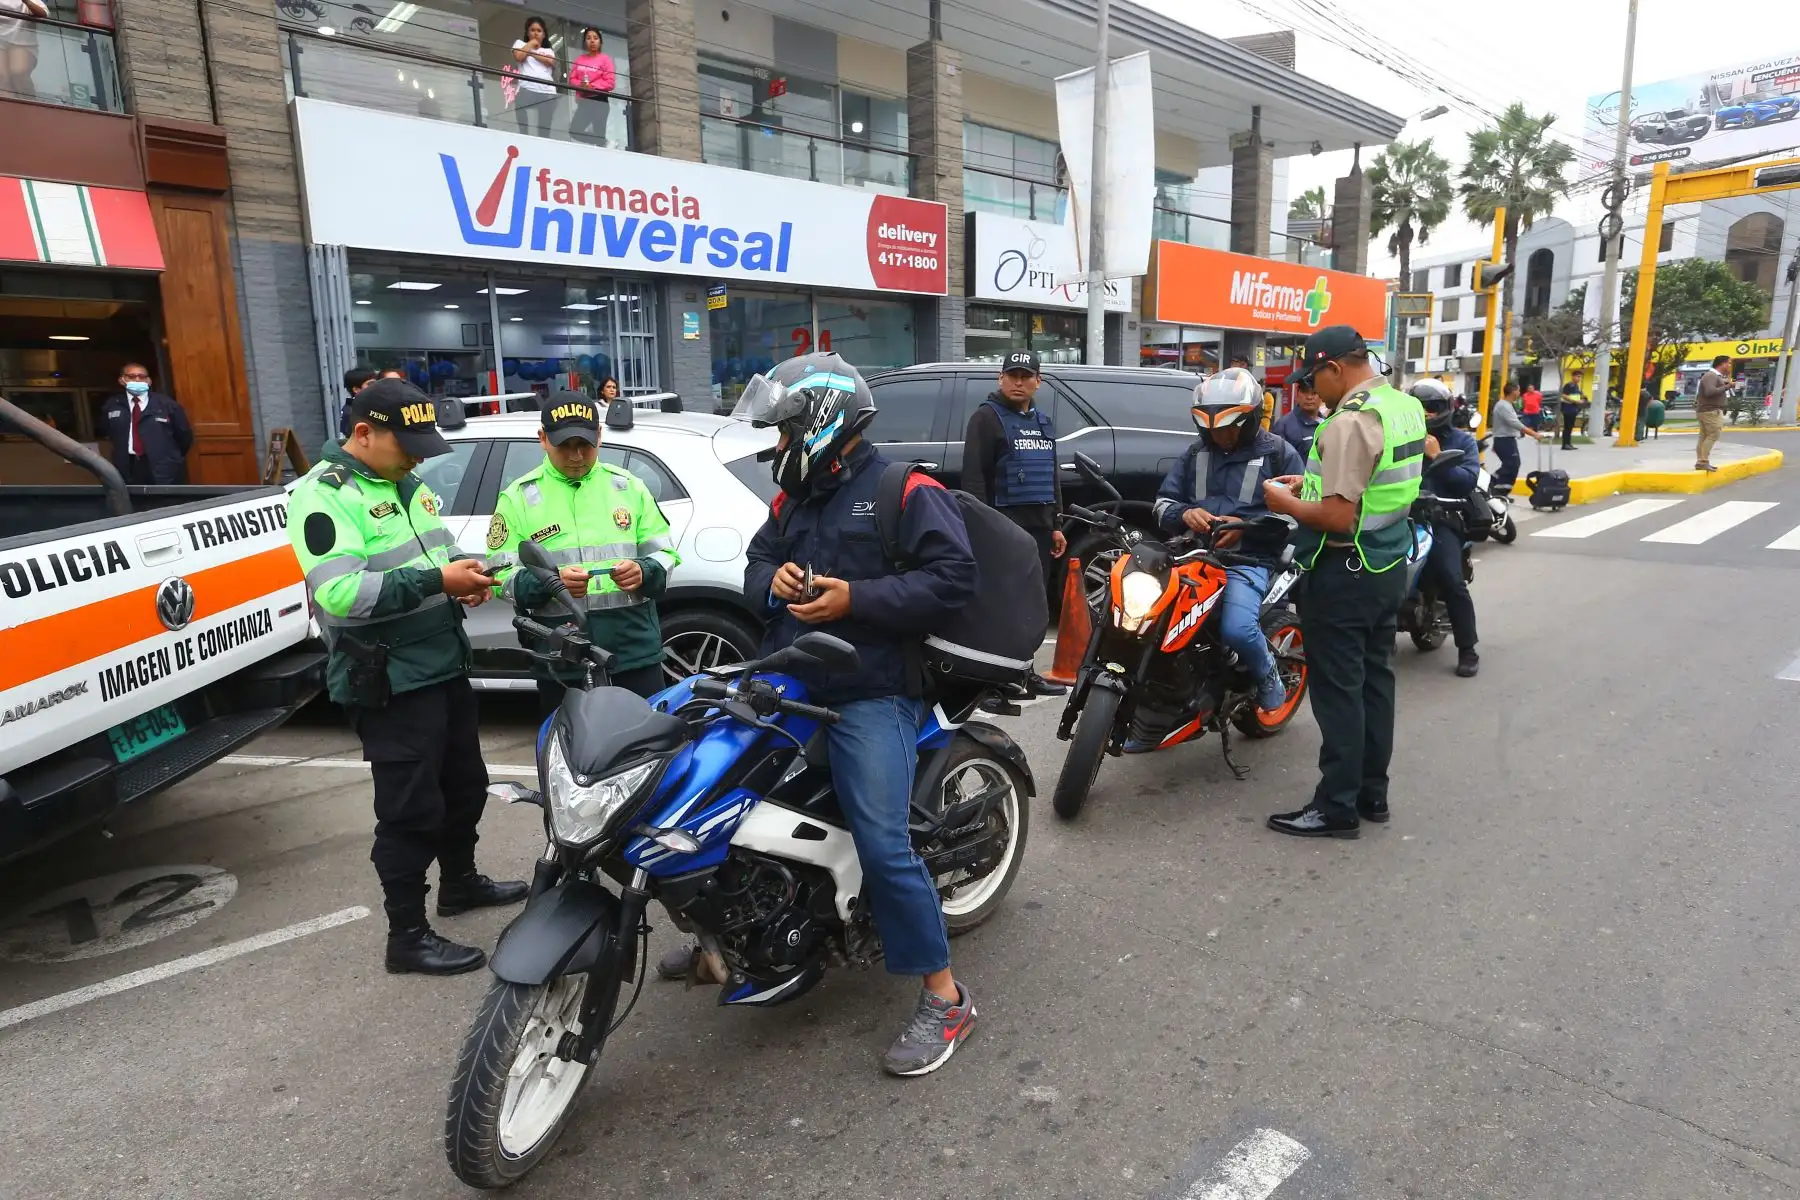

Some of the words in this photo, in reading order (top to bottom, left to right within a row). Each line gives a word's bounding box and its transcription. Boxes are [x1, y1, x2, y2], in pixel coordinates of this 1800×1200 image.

[1711, 69, 1744, 81] NISSAN
[1746, 62, 1772, 73] CADA
[1774, 57, 1793, 67] VEZ
[536, 168, 700, 220] farmacia
[440, 153, 793, 273] Universal
[878, 223, 937, 248] delivery
[1230, 270, 1304, 312] Mifarma
[1011, 353, 1031, 363] GIR
[368, 410, 389, 422] PERU
[551, 403, 593, 422] POLICIA
[1014, 439, 1053, 450] SERENAZGO
[183, 503, 288, 551] TRANSITO
[98, 646, 171, 702] IMAGEN
[174, 637, 196, 671] DE
[197, 607, 274, 662] CONFIANZA
[0, 680, 88, 727] AMAROK
